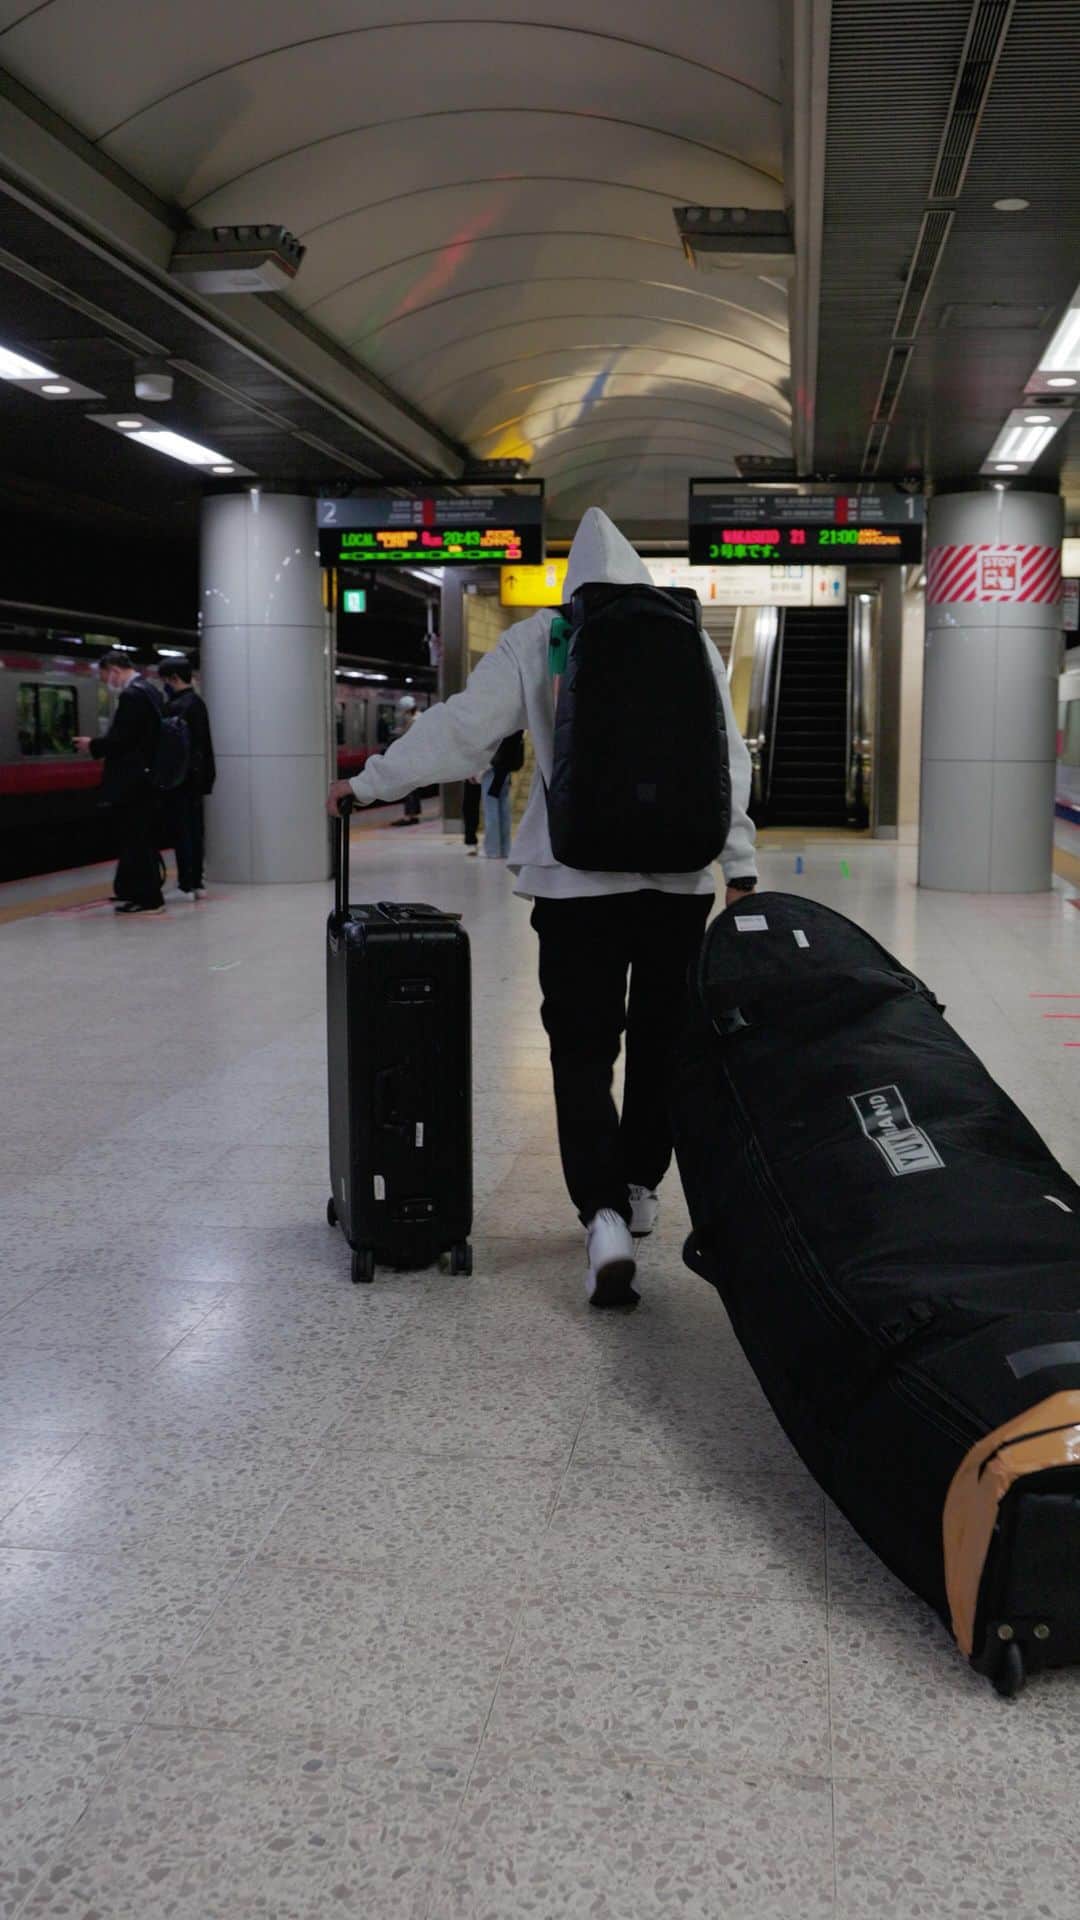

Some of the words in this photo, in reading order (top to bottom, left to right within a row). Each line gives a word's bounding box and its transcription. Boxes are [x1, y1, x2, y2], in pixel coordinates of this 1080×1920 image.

[323, 502, 337, 523] 2
[904, 497, 915, 519] 1
[341, 533, 377, 547] LOCAL
[443, 531, 481, 546] 20:43
[818, 529, 858, 545] 21:00
